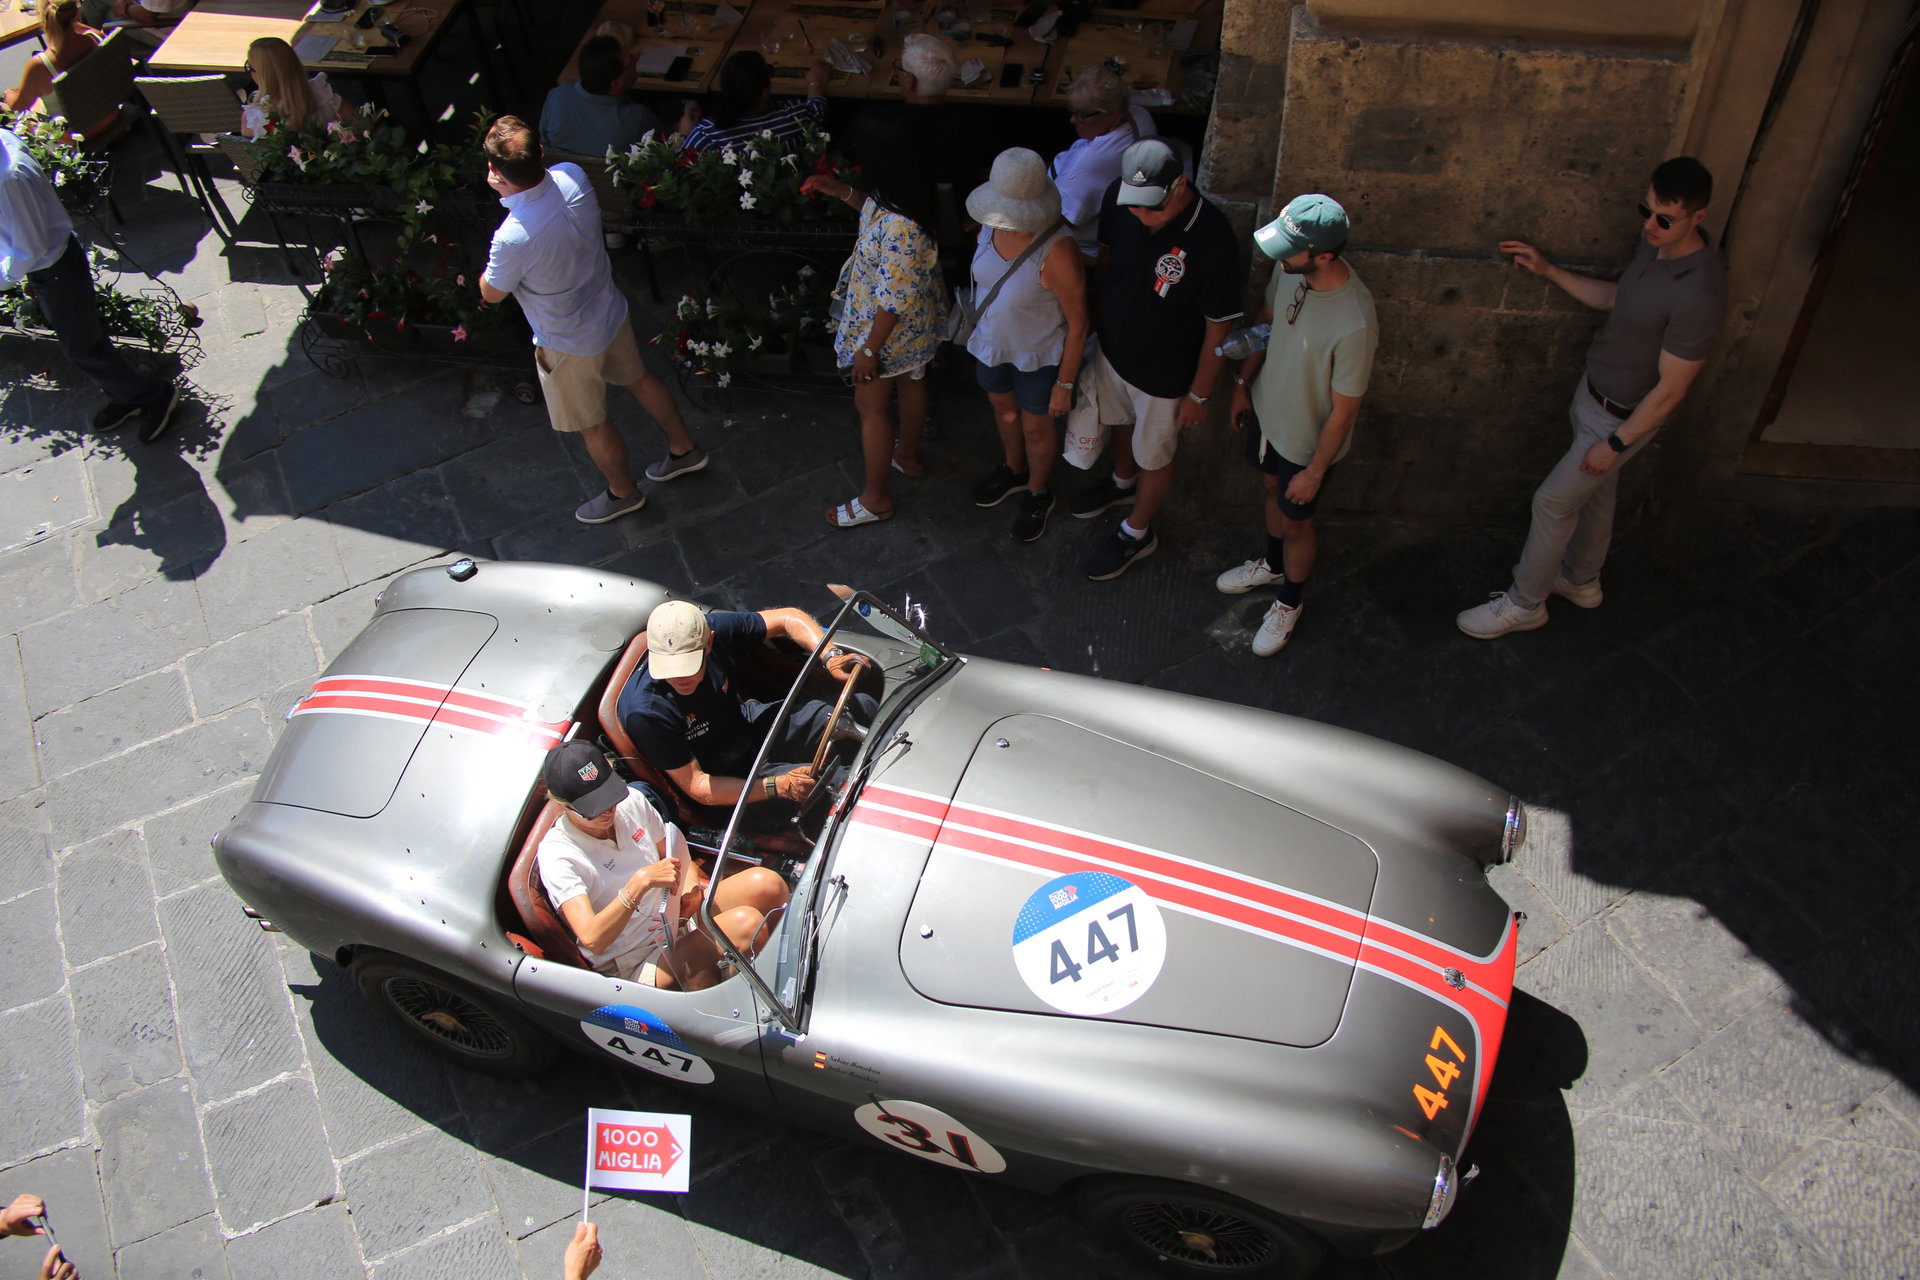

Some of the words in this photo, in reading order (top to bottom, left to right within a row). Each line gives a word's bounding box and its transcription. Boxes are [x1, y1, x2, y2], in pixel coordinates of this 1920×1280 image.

[578, 762, 595, 776] TAG
[1050, 892, 1068, 904] 1000
[1054, 894, 1079, 910] MIGLIA
[1050, 903, 1139, 985] 447
[624, 1020, 641, 1029] 1000
[625, 1025, 648, 1036] MIGLIA
[606, 1036, 694, 1073] 447
[1413, 1025, 1467, 1121] 447
[602, 1128, 659, 1147] 1000
[877, 1113, 979, 1168] 31
[598, 1150, 662, 1170] MIGLIA
